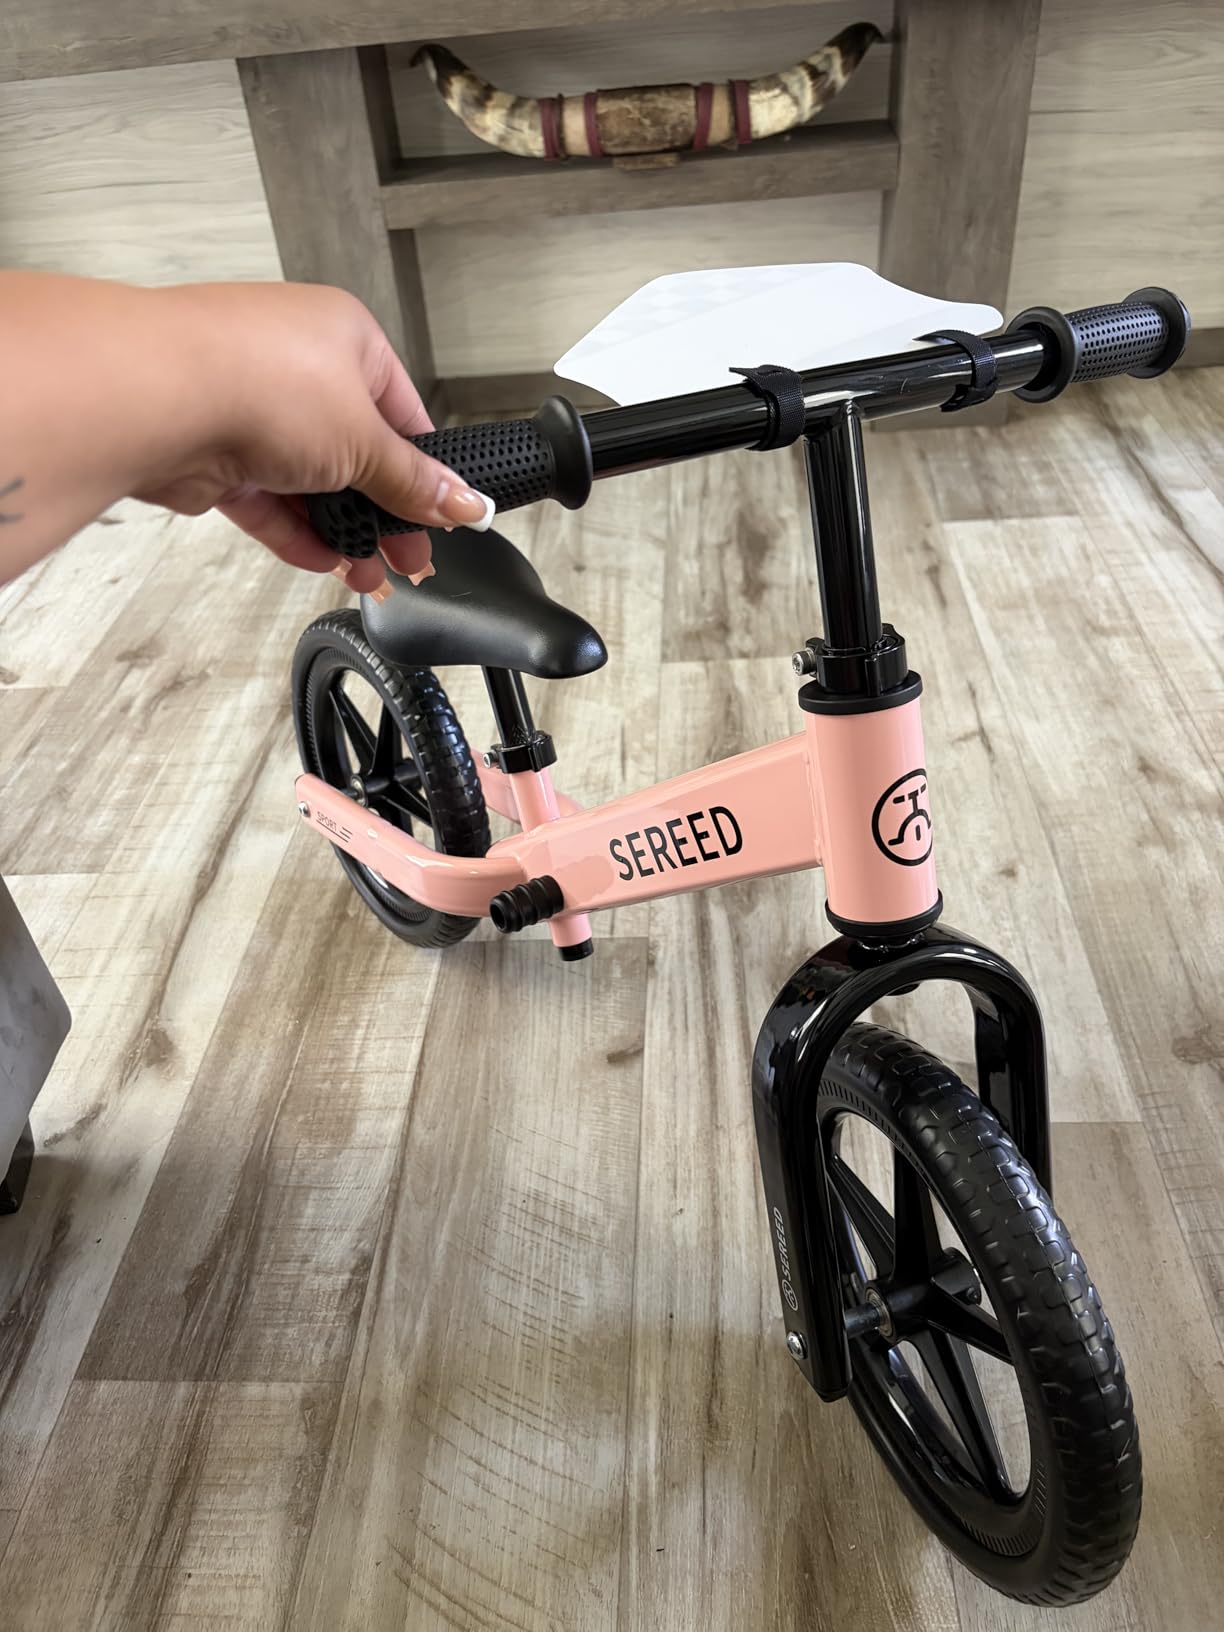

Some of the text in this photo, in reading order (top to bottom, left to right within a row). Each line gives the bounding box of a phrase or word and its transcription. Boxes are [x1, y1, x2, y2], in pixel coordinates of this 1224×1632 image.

[317, 811, 337, 832] SPORT
[609, 806, 743, 881] SEREED
[773, 1206, 792, 1282] SEREED
